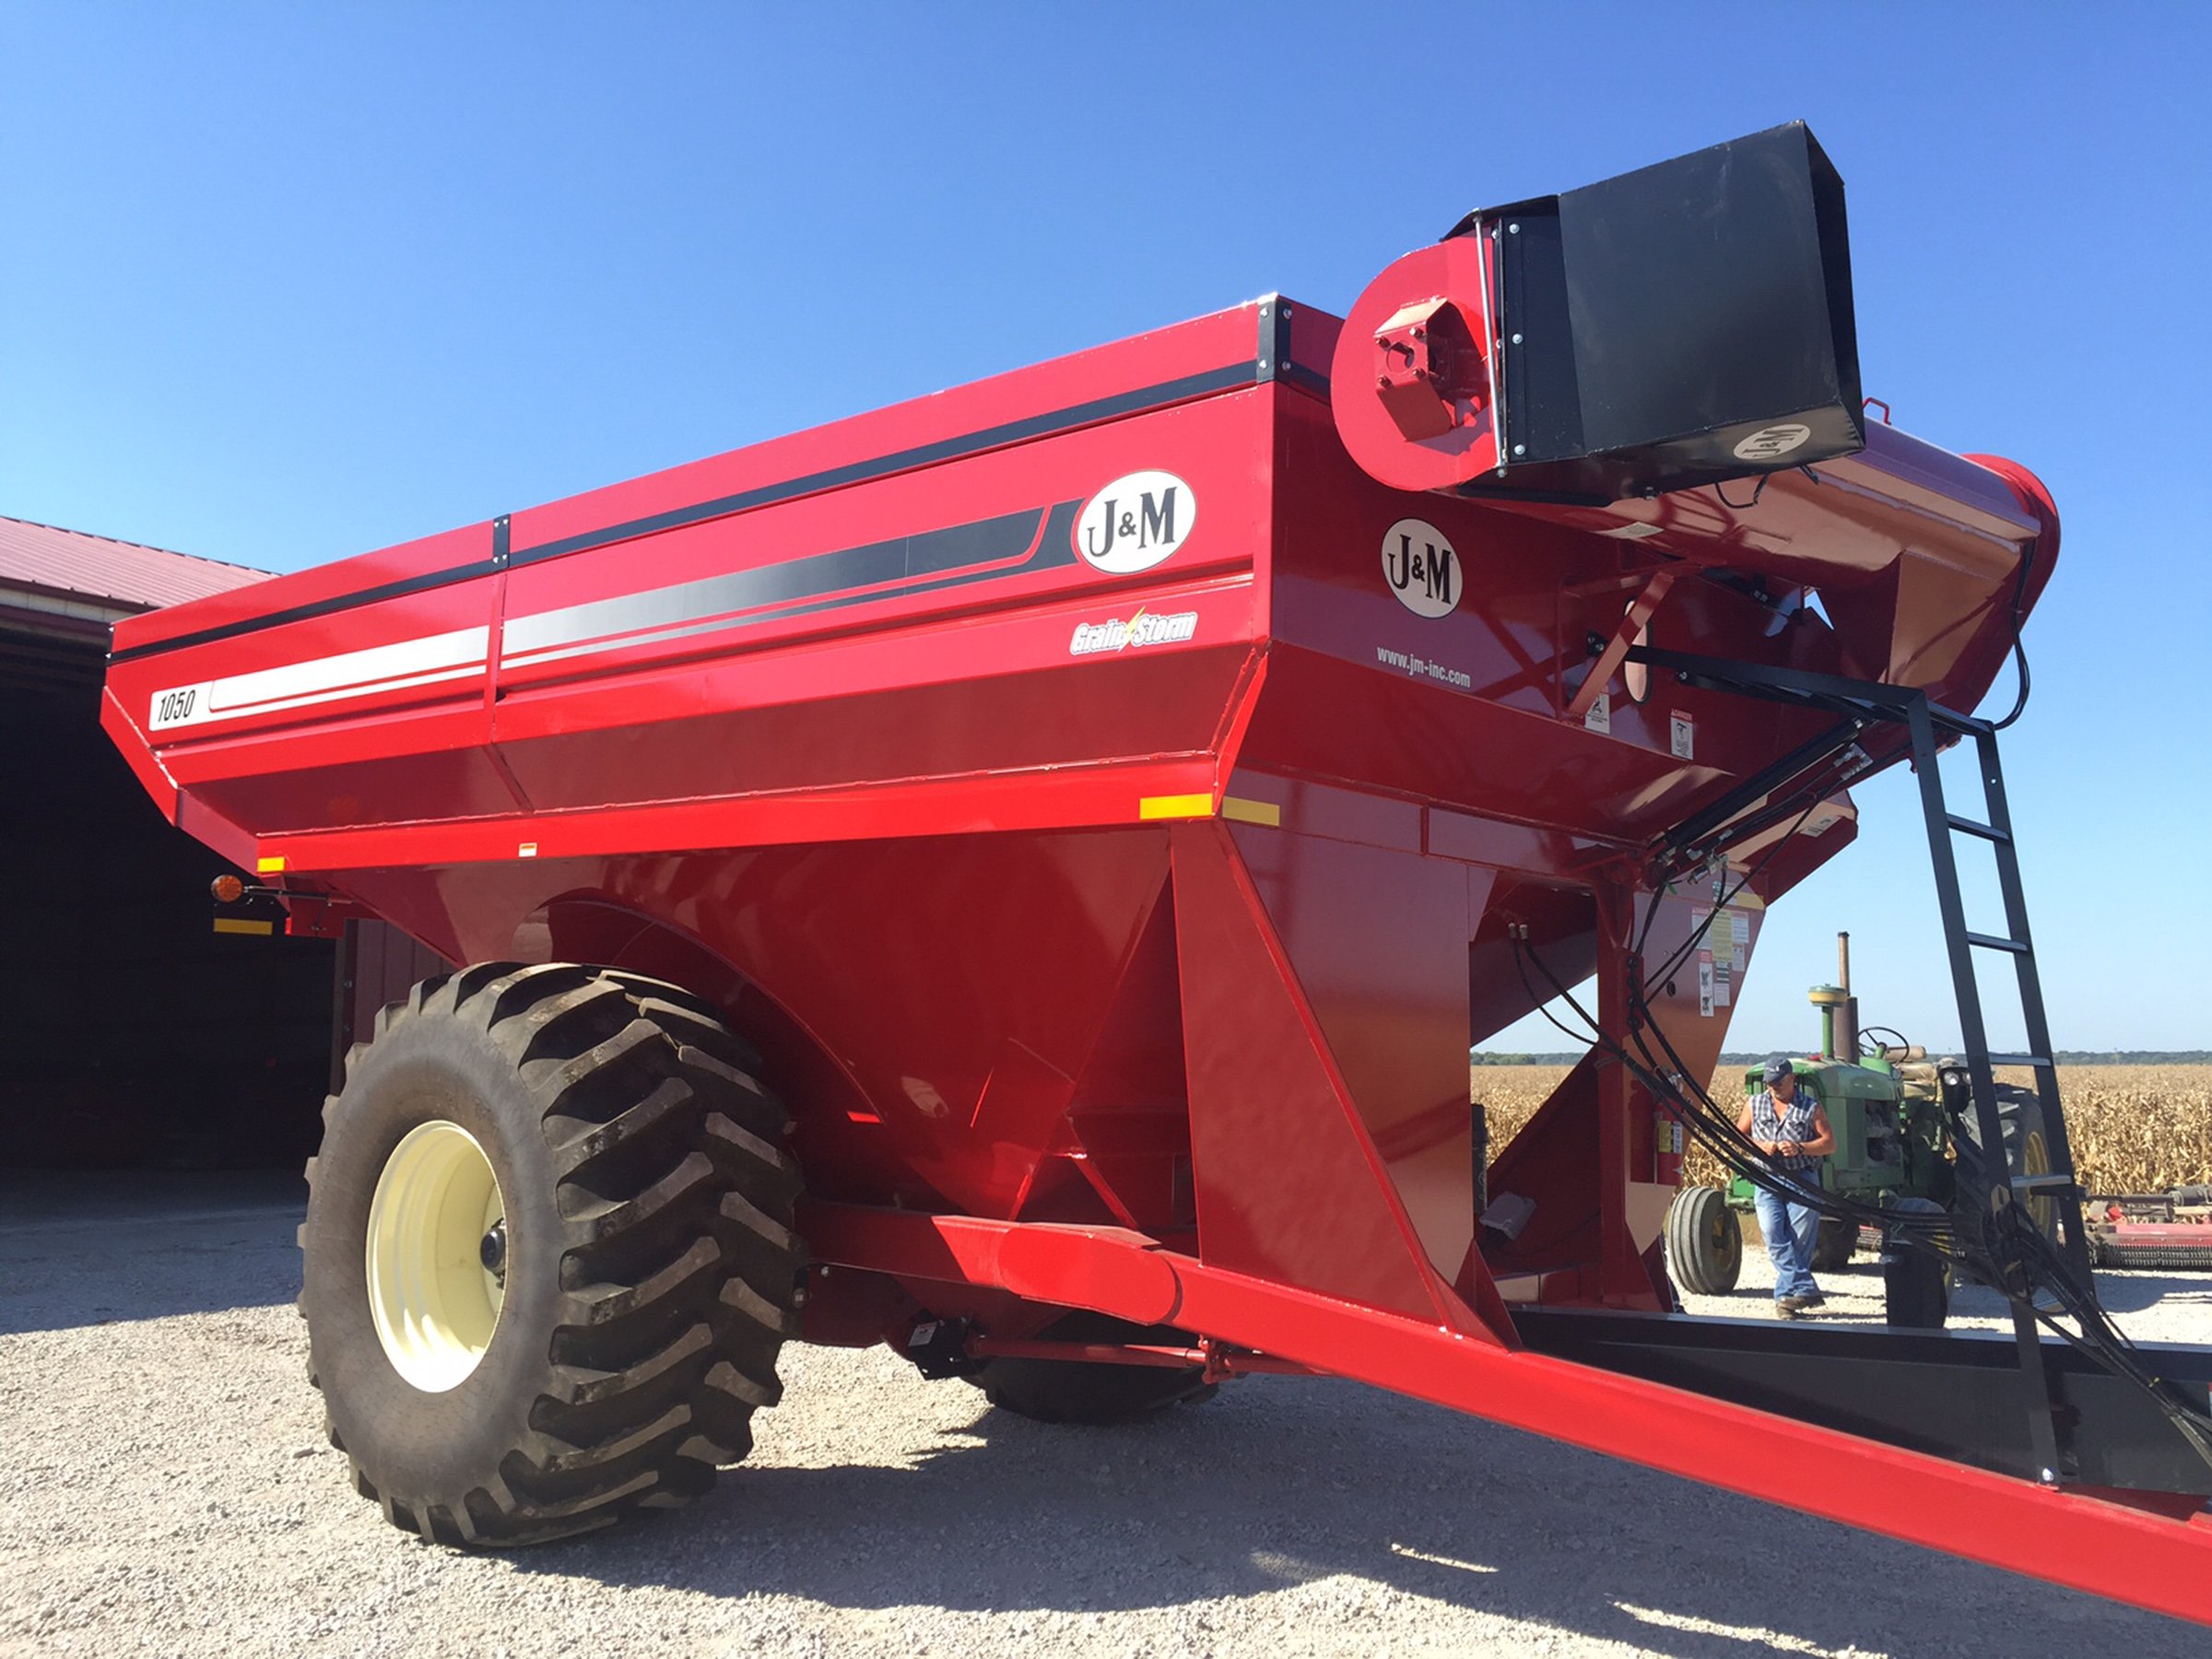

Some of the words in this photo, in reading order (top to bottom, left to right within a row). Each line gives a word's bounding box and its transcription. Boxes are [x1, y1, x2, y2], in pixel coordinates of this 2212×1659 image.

[1088, 487, 1177, 558] J&M
[1388, 534, 1452, 605] J&M
[1070, 621, 1128, 655] Grain
[1131, 612, 1197, 647] Storm
[1377, 647, 1471, 688] www.jm-inc.com
[158, 689, 196, 723] 1050
